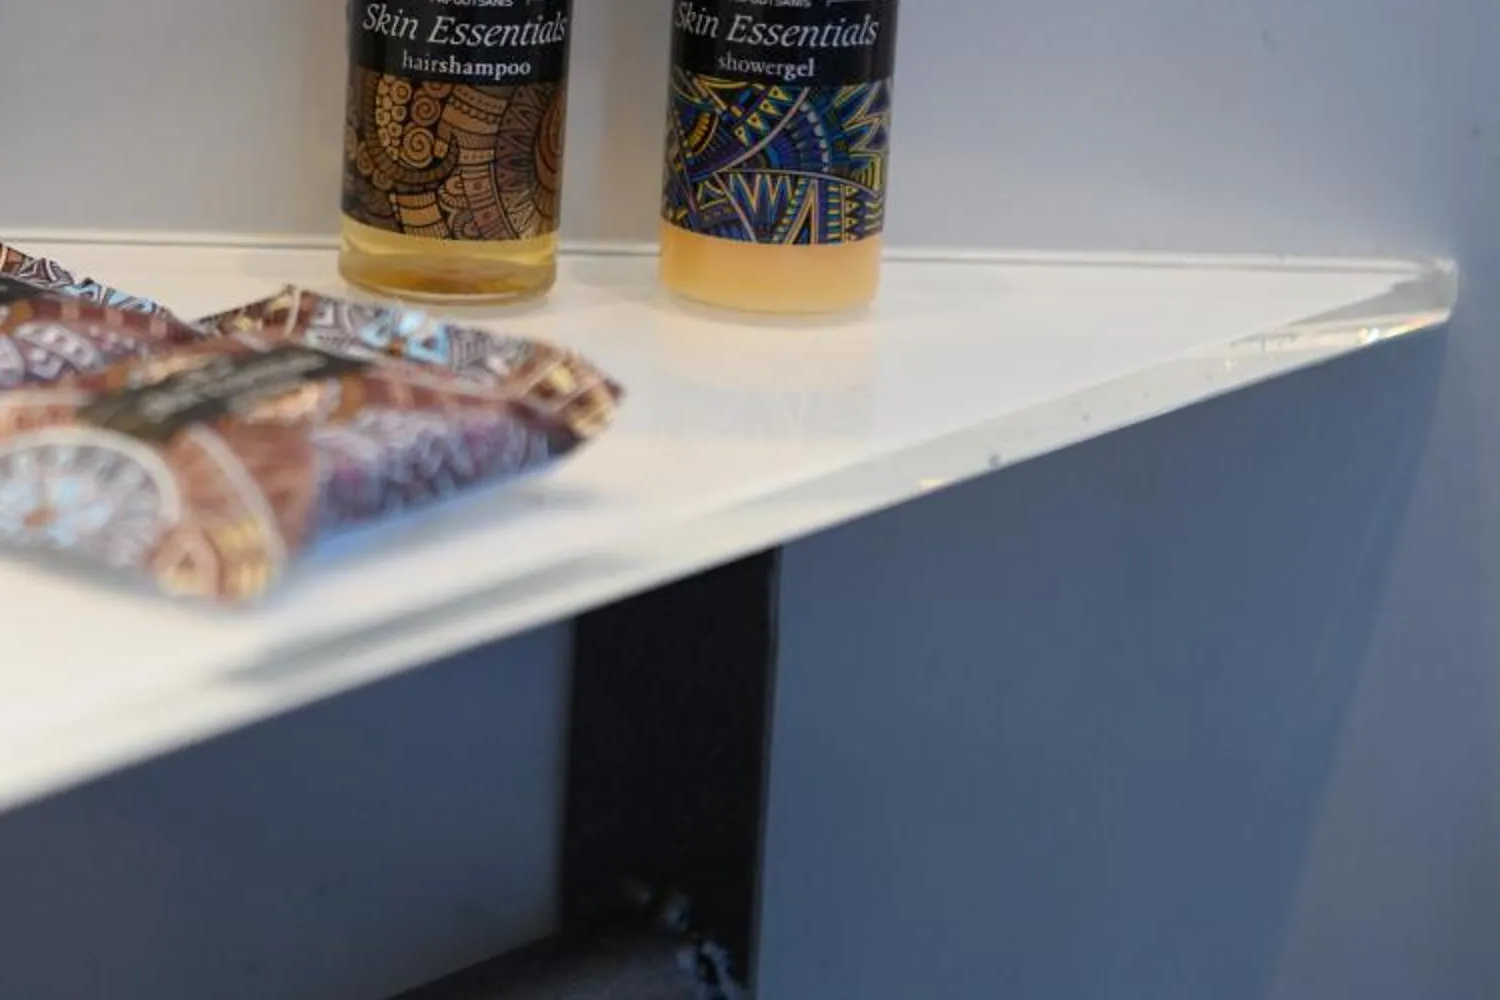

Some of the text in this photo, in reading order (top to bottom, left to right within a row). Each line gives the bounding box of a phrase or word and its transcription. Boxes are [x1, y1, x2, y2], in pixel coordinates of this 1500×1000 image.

[363, 3, 568, 47] Skin Essentials
[675, 1, 880, 47] Skin Essentials
[402, 49, 531, 80] hairshampoo
[717, 52, 815, 80] showergel
